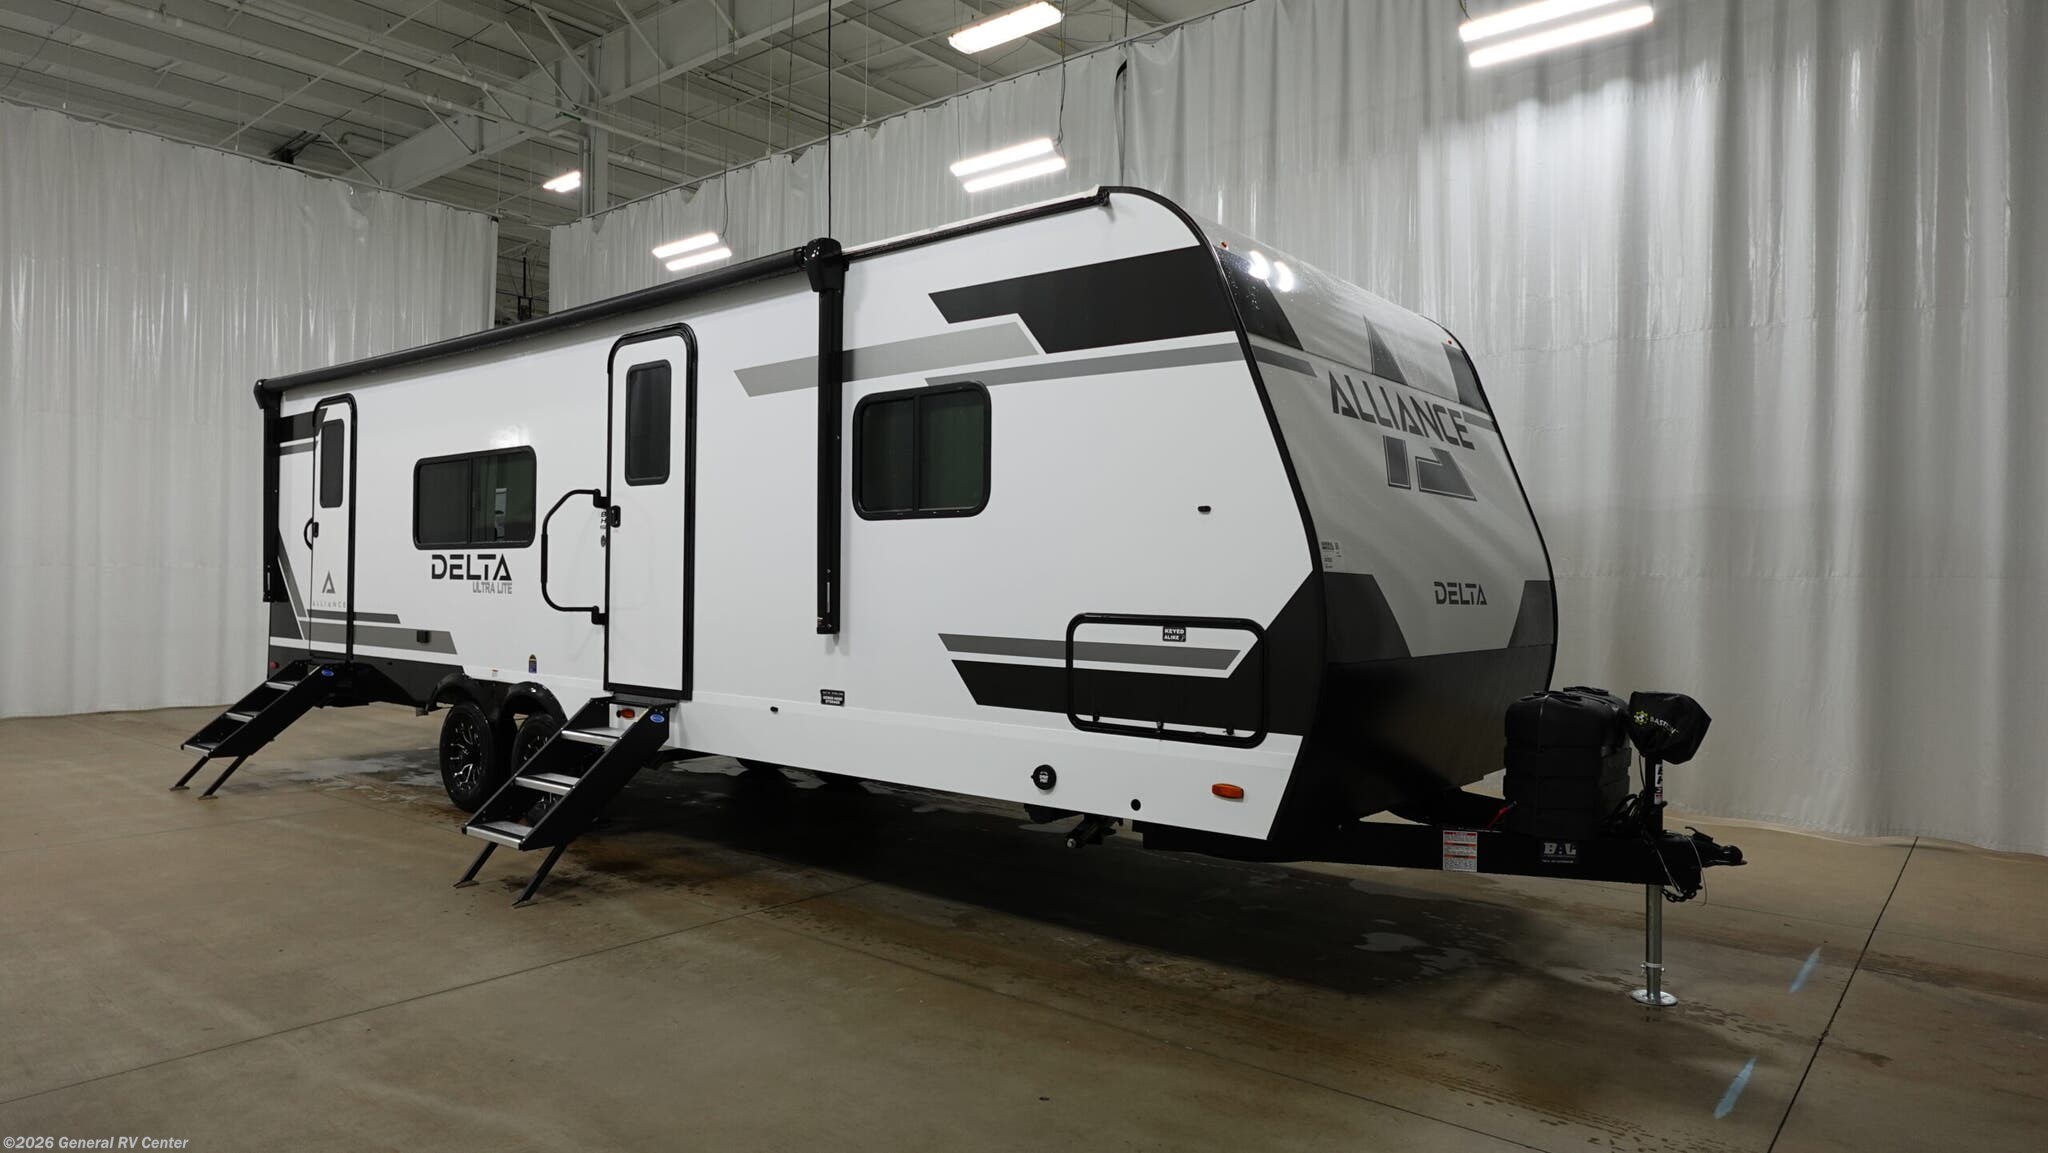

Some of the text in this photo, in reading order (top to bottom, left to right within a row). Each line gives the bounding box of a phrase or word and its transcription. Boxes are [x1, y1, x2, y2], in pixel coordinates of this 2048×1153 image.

[1329, 371, 1476, 451] ALLIANCE
[432, 553, 512, 581] DELTA
[473, 581, 512, 594] ULTRA LITE
[1434, 581, 1488, 606] DELTA
